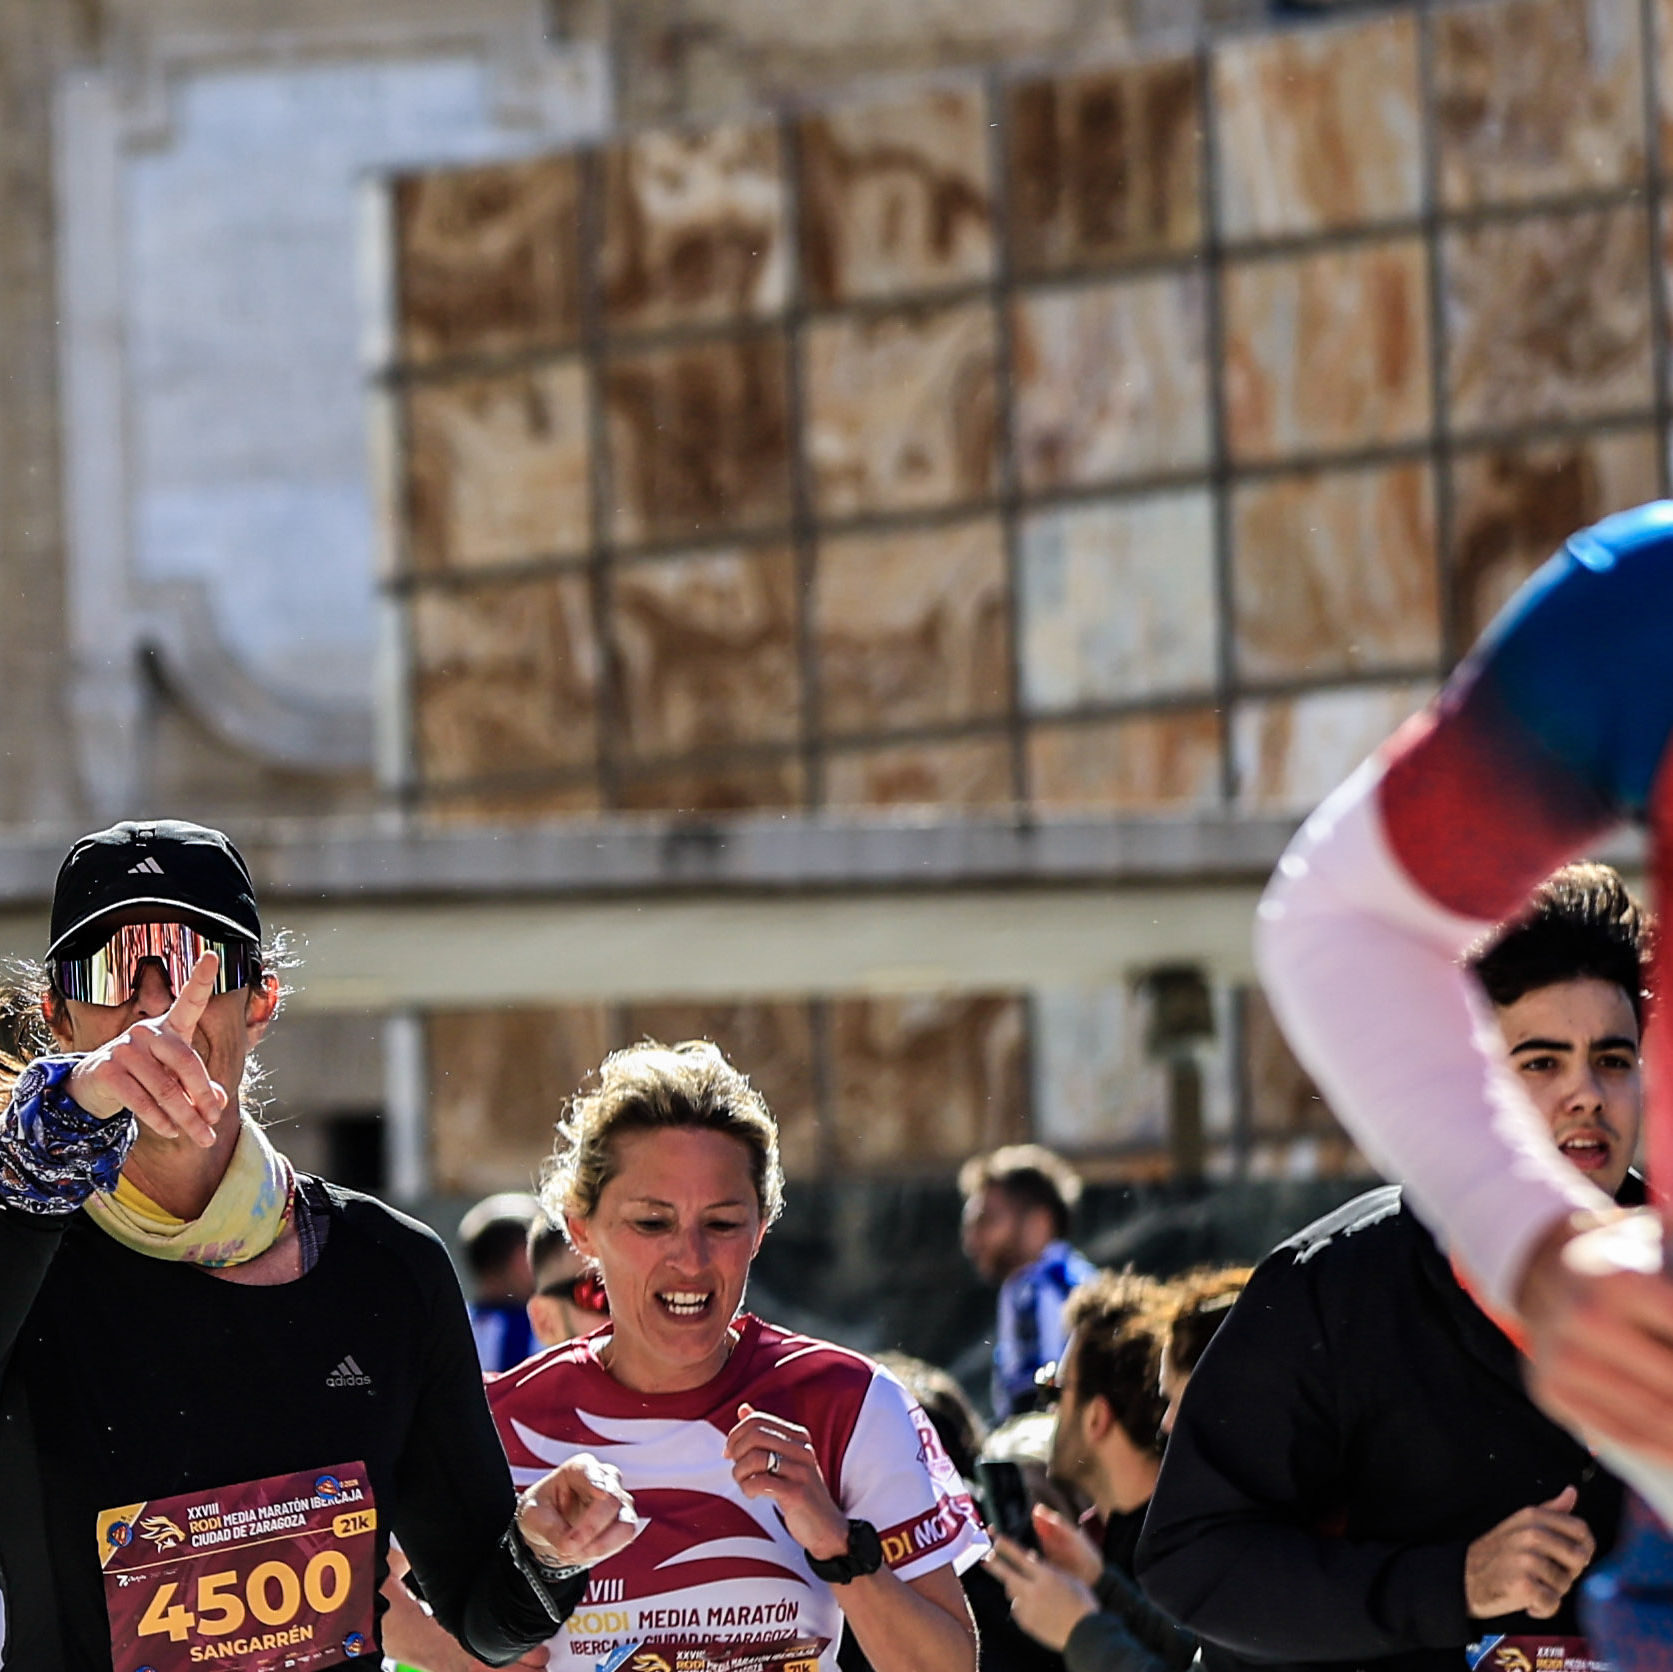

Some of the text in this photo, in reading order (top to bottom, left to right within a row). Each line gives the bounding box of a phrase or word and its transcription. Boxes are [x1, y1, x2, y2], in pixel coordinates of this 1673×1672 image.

[326, 1375, 372, 1387] adidas
[187, 1502, 220, 1520] XXVIII
[189, 1517, 222, 1534] RODI
[222, 1508, 257, 1527] MEDIA
[257, 1497, 310, 1519] MARATÓN
[339, 1515, 369, 1534] 21k
[191, 1512, 307, 1548] CIUDAD DE ZARAGOZA
[880, 1532, 913, 1563] DI
[137, 1550, 352, 1643] 4500
[566, 1597, 799, 1635] RODI MEDIA MARATÓN
[189, 1624, 314, 1663] SANGARRÉN
